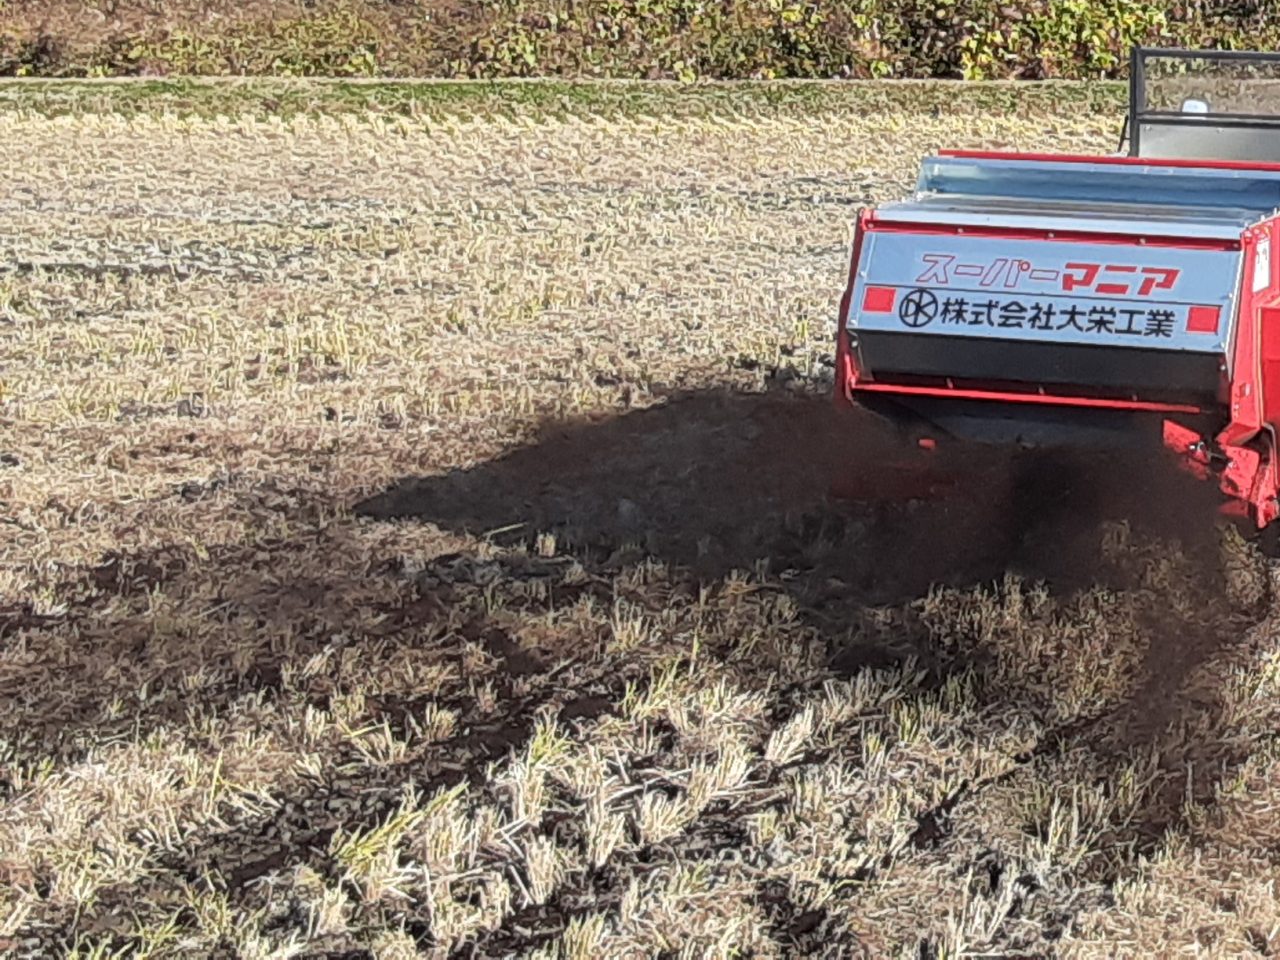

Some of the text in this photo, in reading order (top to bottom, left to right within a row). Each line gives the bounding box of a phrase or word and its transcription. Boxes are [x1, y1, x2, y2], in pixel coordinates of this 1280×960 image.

[915, 253, 1180, 296] スーパーマニア
[940, 297, 1176, 338] 株式会社大栄工業
